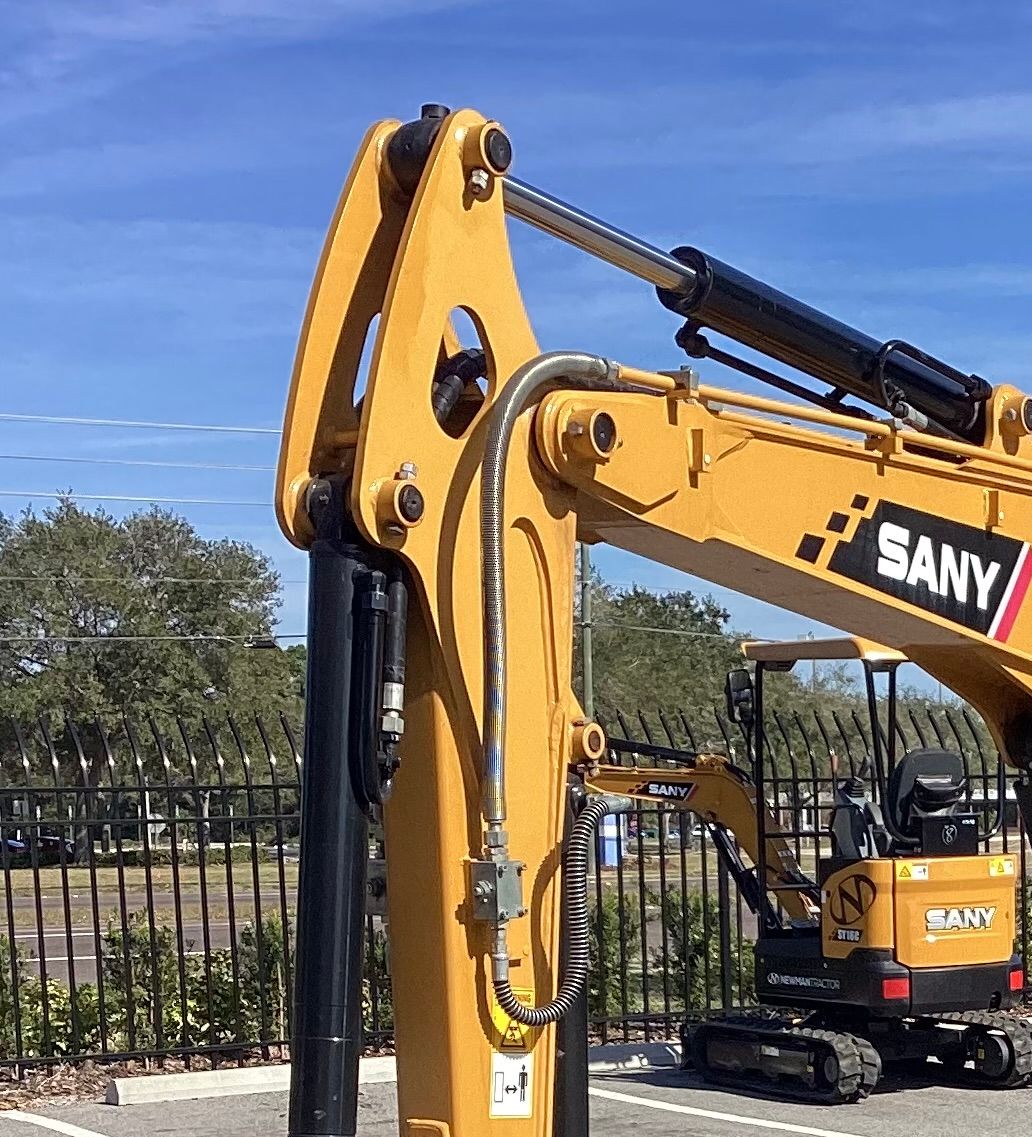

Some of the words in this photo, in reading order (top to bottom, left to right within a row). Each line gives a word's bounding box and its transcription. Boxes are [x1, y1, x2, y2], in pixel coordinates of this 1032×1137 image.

[877, 521, 1001, 611] SANY
[648, 783, 688, 797] SANY
[925, 906, 997, 931] SANY
